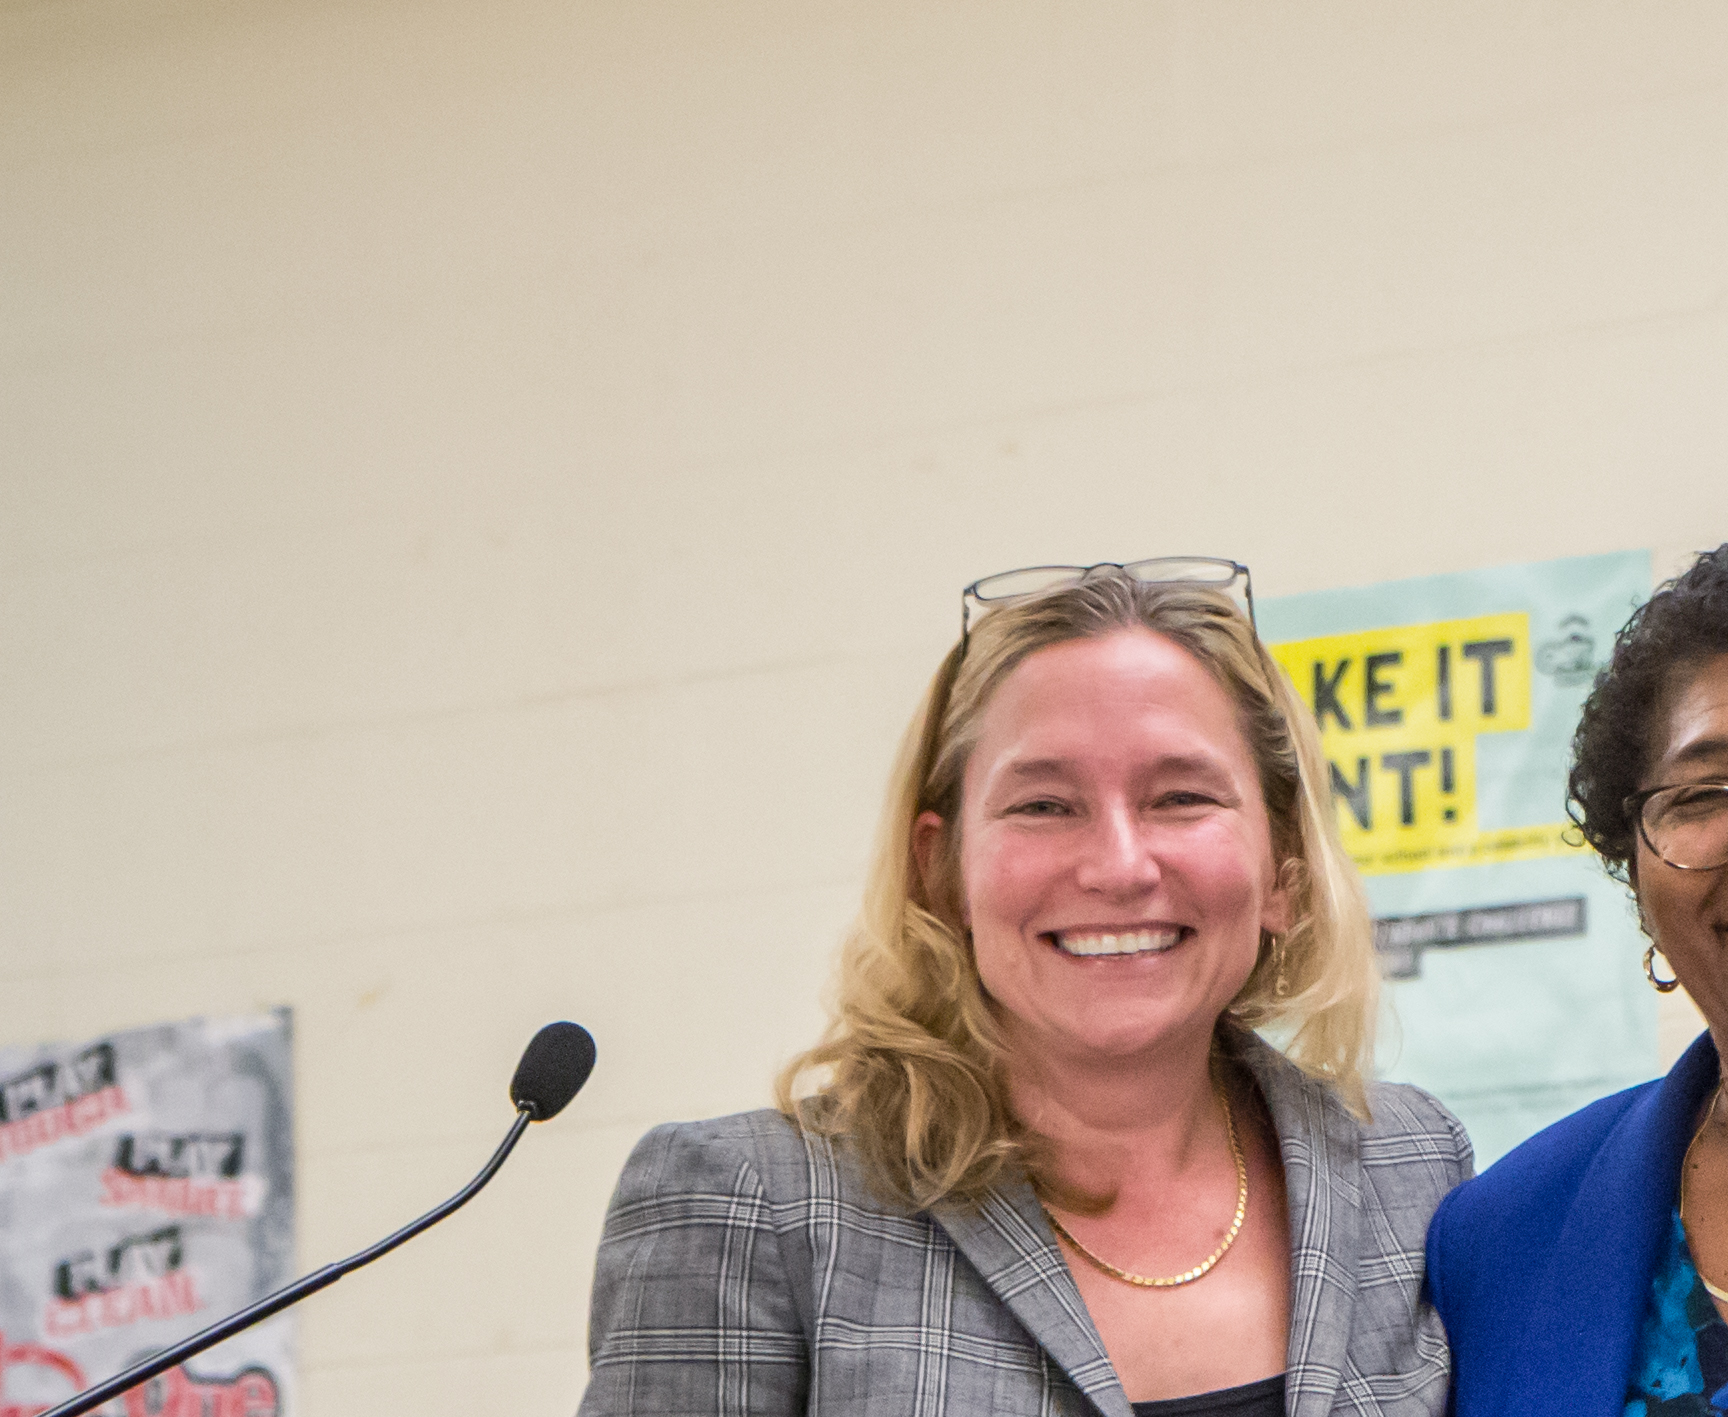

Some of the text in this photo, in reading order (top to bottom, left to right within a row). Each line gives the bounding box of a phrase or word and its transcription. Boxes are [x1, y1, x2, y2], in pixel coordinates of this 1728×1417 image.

[1312, 637, 1514, 735] KE IT
[1329, 745, 1457, 832] NT!
